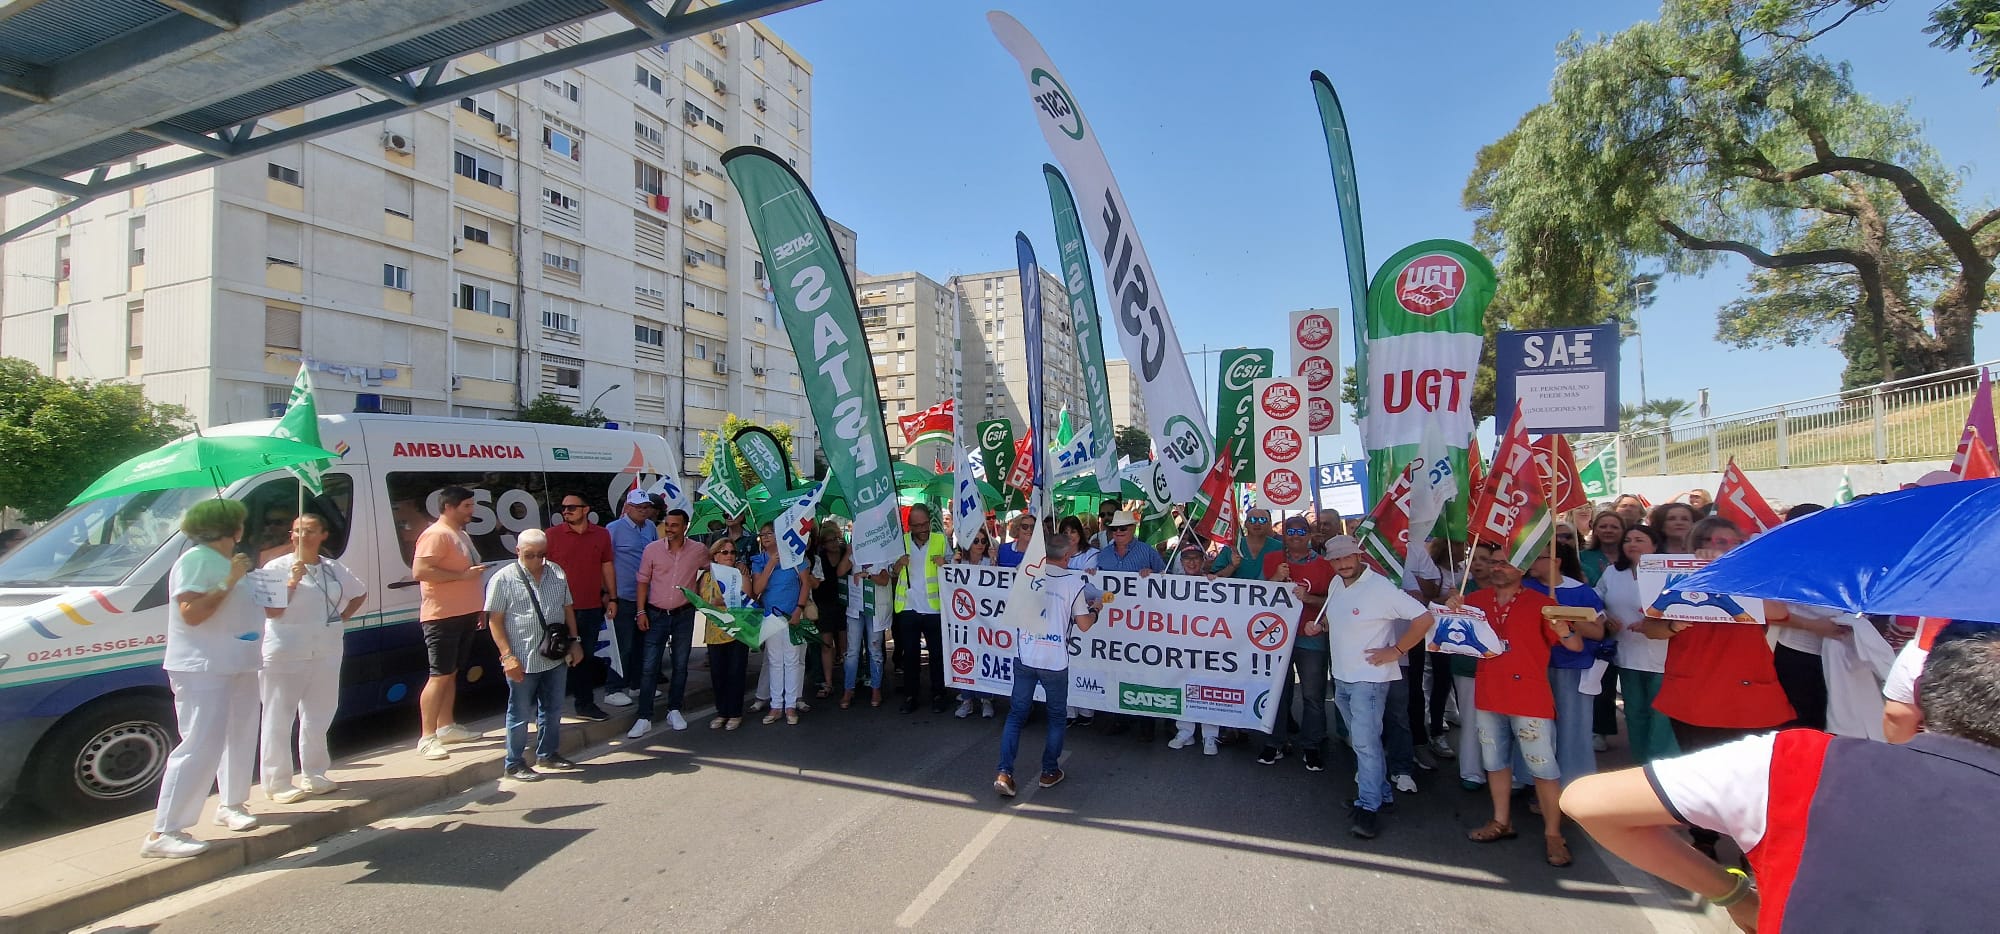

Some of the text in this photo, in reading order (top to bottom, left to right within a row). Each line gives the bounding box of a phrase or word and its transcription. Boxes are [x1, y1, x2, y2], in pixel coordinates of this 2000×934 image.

[1406, 265, 1457, 290] UGT
[1303, 318, 1325, 330] UGT
[1233, 365, 1266, 378] CSIF
[1304, 359, 1326, 371] UGT
[1269, 386, 1292, 399] UGT
[1384, 368, 1467, 414] UGT
[987, 430, 1008, 441] CSIF
[1229, 395, 1254, 479] CSIF
[1270, 429, 1293, 441] UGT
[393, 442, 524, 459] AMBULANCIA
[1270, 472, 1293, 484] UGT
[944, 567, 971, 585] EN
[1102, 575, 1137, 597] DE
[1148, 579, 1293, 609] NUESTRA
[1108, 604, 1233, 639] PÚBLICA
[977, 626, 1013, 649] NO
[1091, 638, 1239, 673] RECORTES
[1122, 690, 1178, 710] SATSE
[1203, 689, 1242, 702] CCOO
